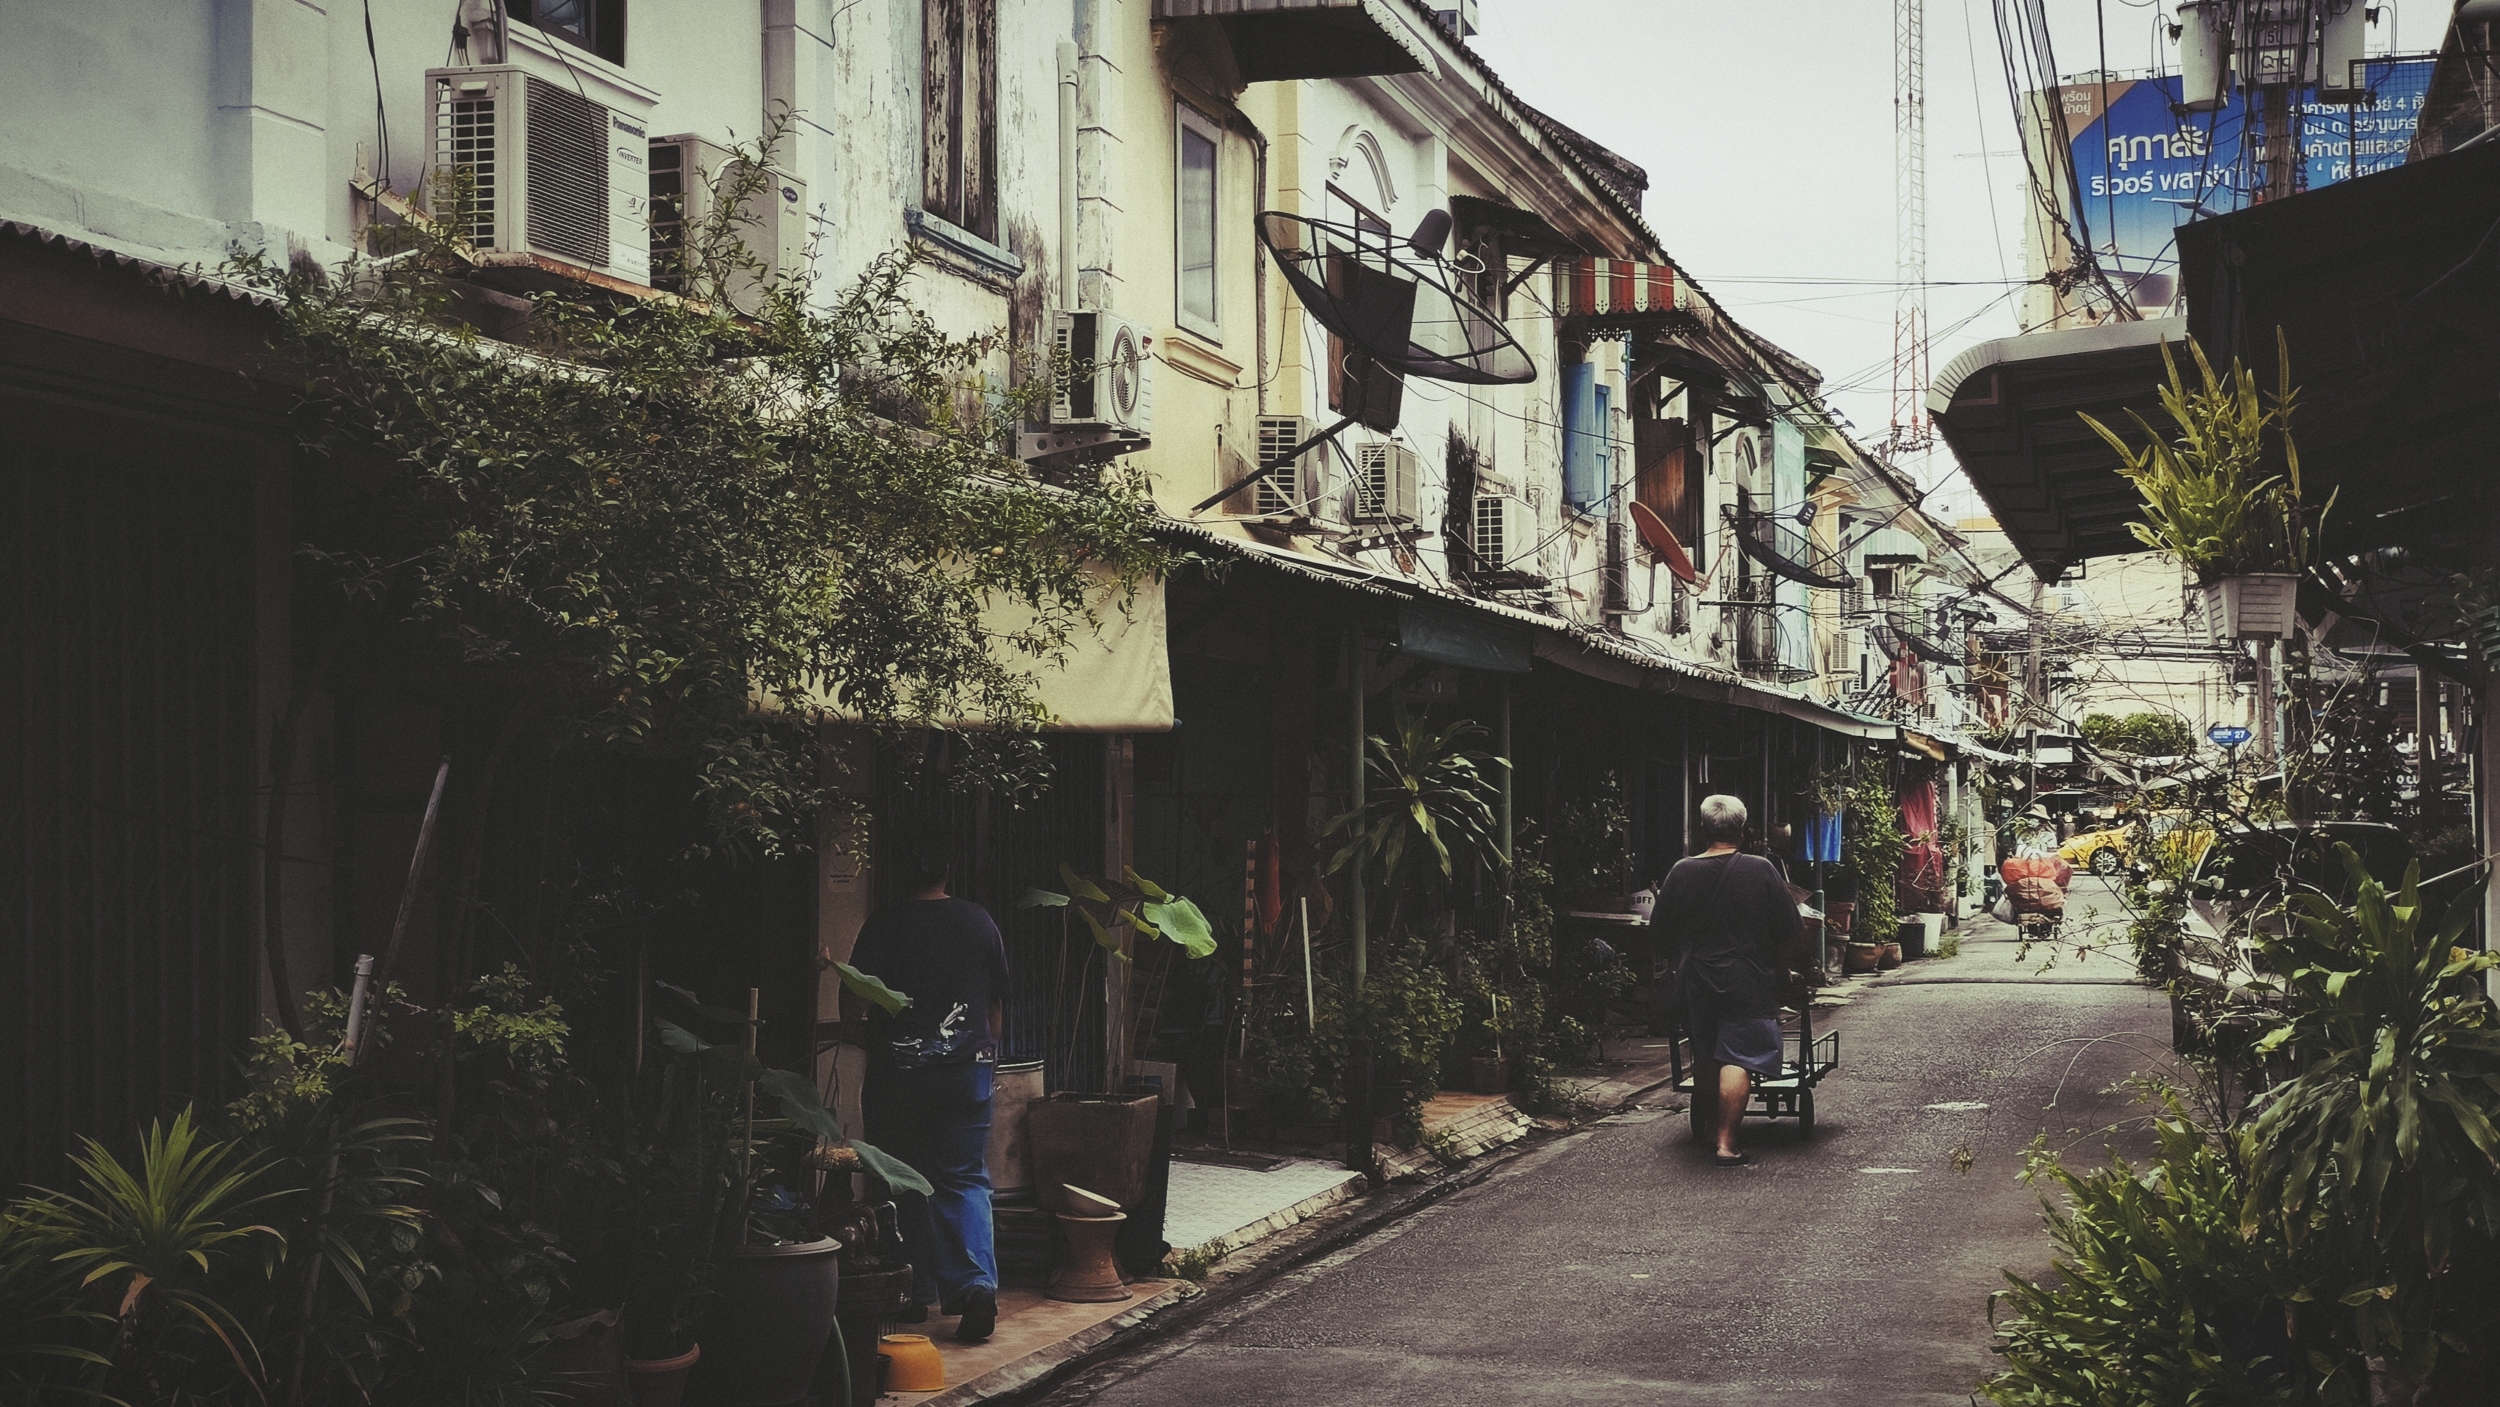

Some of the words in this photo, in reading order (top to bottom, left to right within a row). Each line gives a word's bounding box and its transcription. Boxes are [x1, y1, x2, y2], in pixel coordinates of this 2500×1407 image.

[2396, 96, 2407, 111] 4
[612, 115, 646, 139] Panasonic
[2108, 125, 2212, 171] ศุภาลัย
[618, 150, 643, 166] INVERTER
[2091, 169, 2154, 196] ริเวอร์
[2234, 730, 2246, 739] 27
[1631, 896, 1653, 906] SOFT
